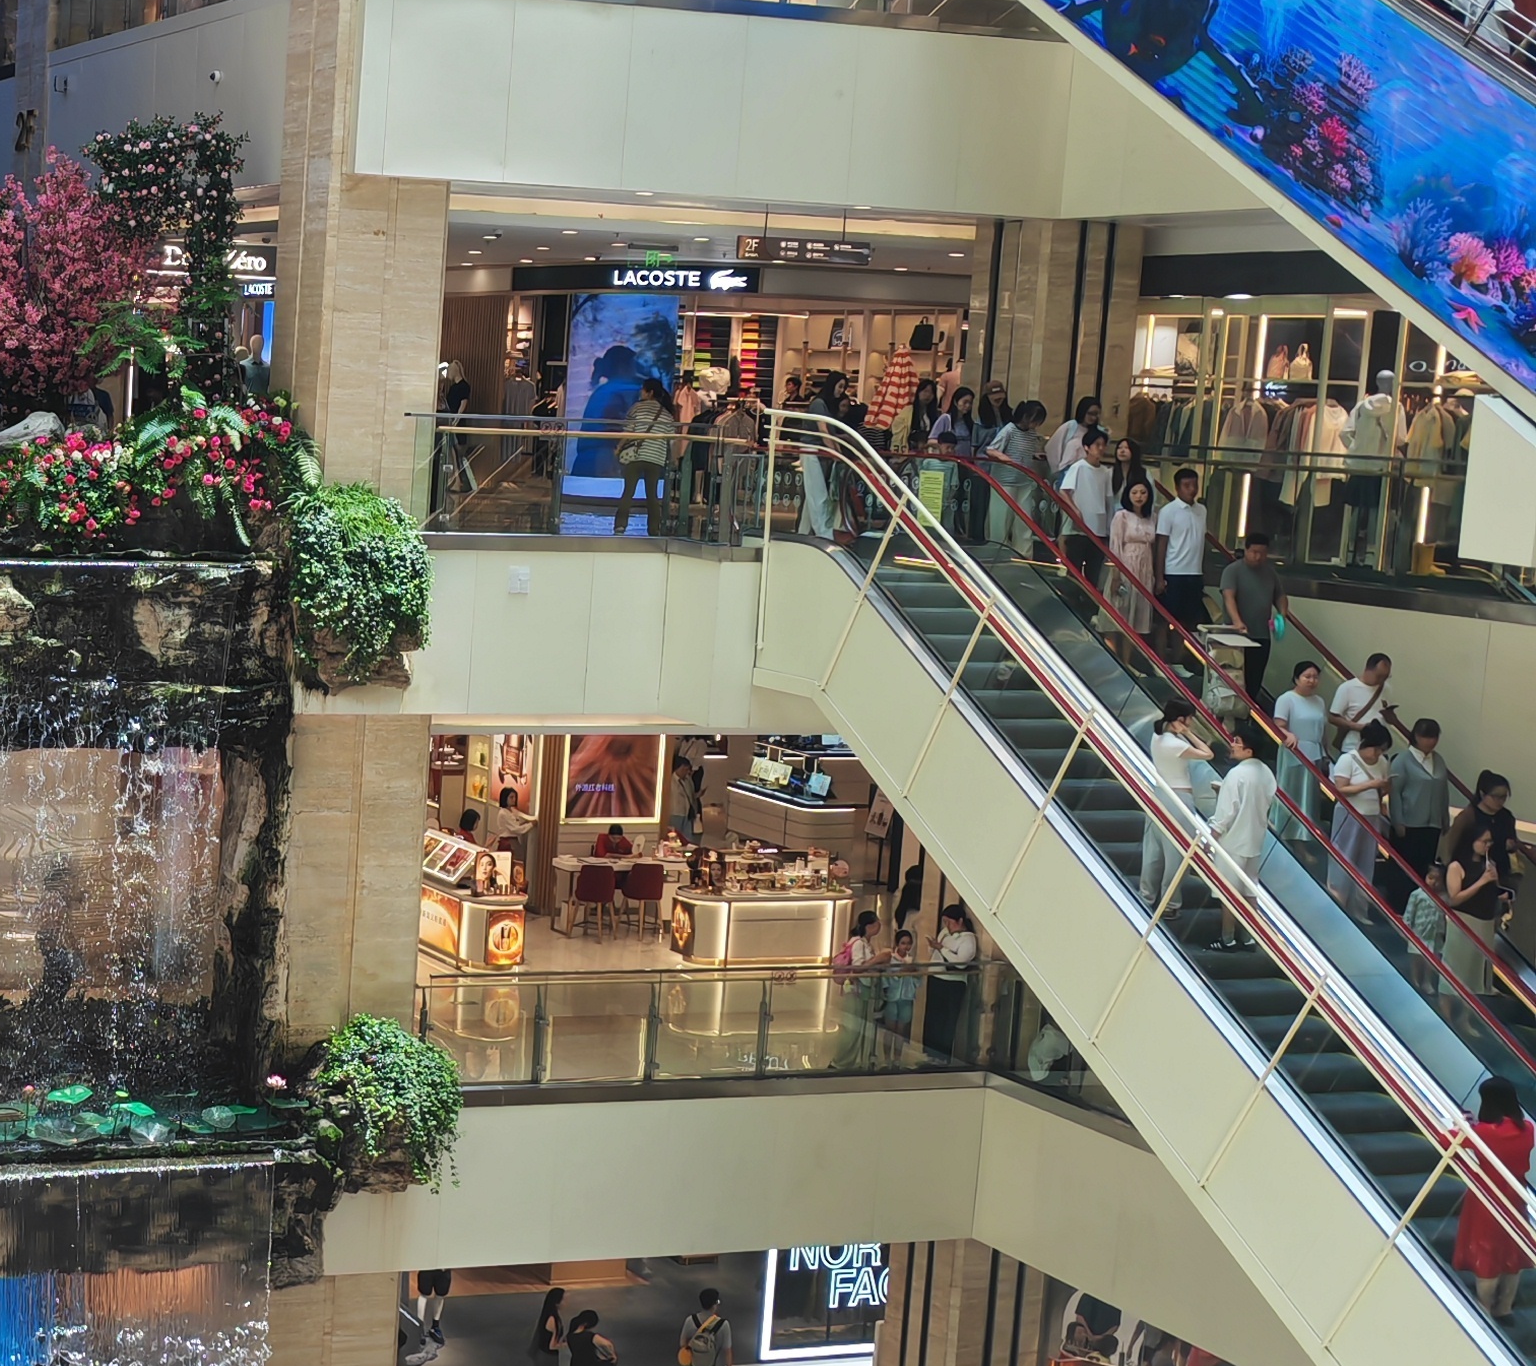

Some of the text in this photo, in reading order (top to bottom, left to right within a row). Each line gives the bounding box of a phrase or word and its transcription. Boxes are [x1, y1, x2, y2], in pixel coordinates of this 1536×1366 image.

[15, 109, 38, 152] 2F
[745, 239, 760, 252] 2F
[613, 269, 702, 287] LACOSTE
[244, 283, 273, 295] LACOSTE
